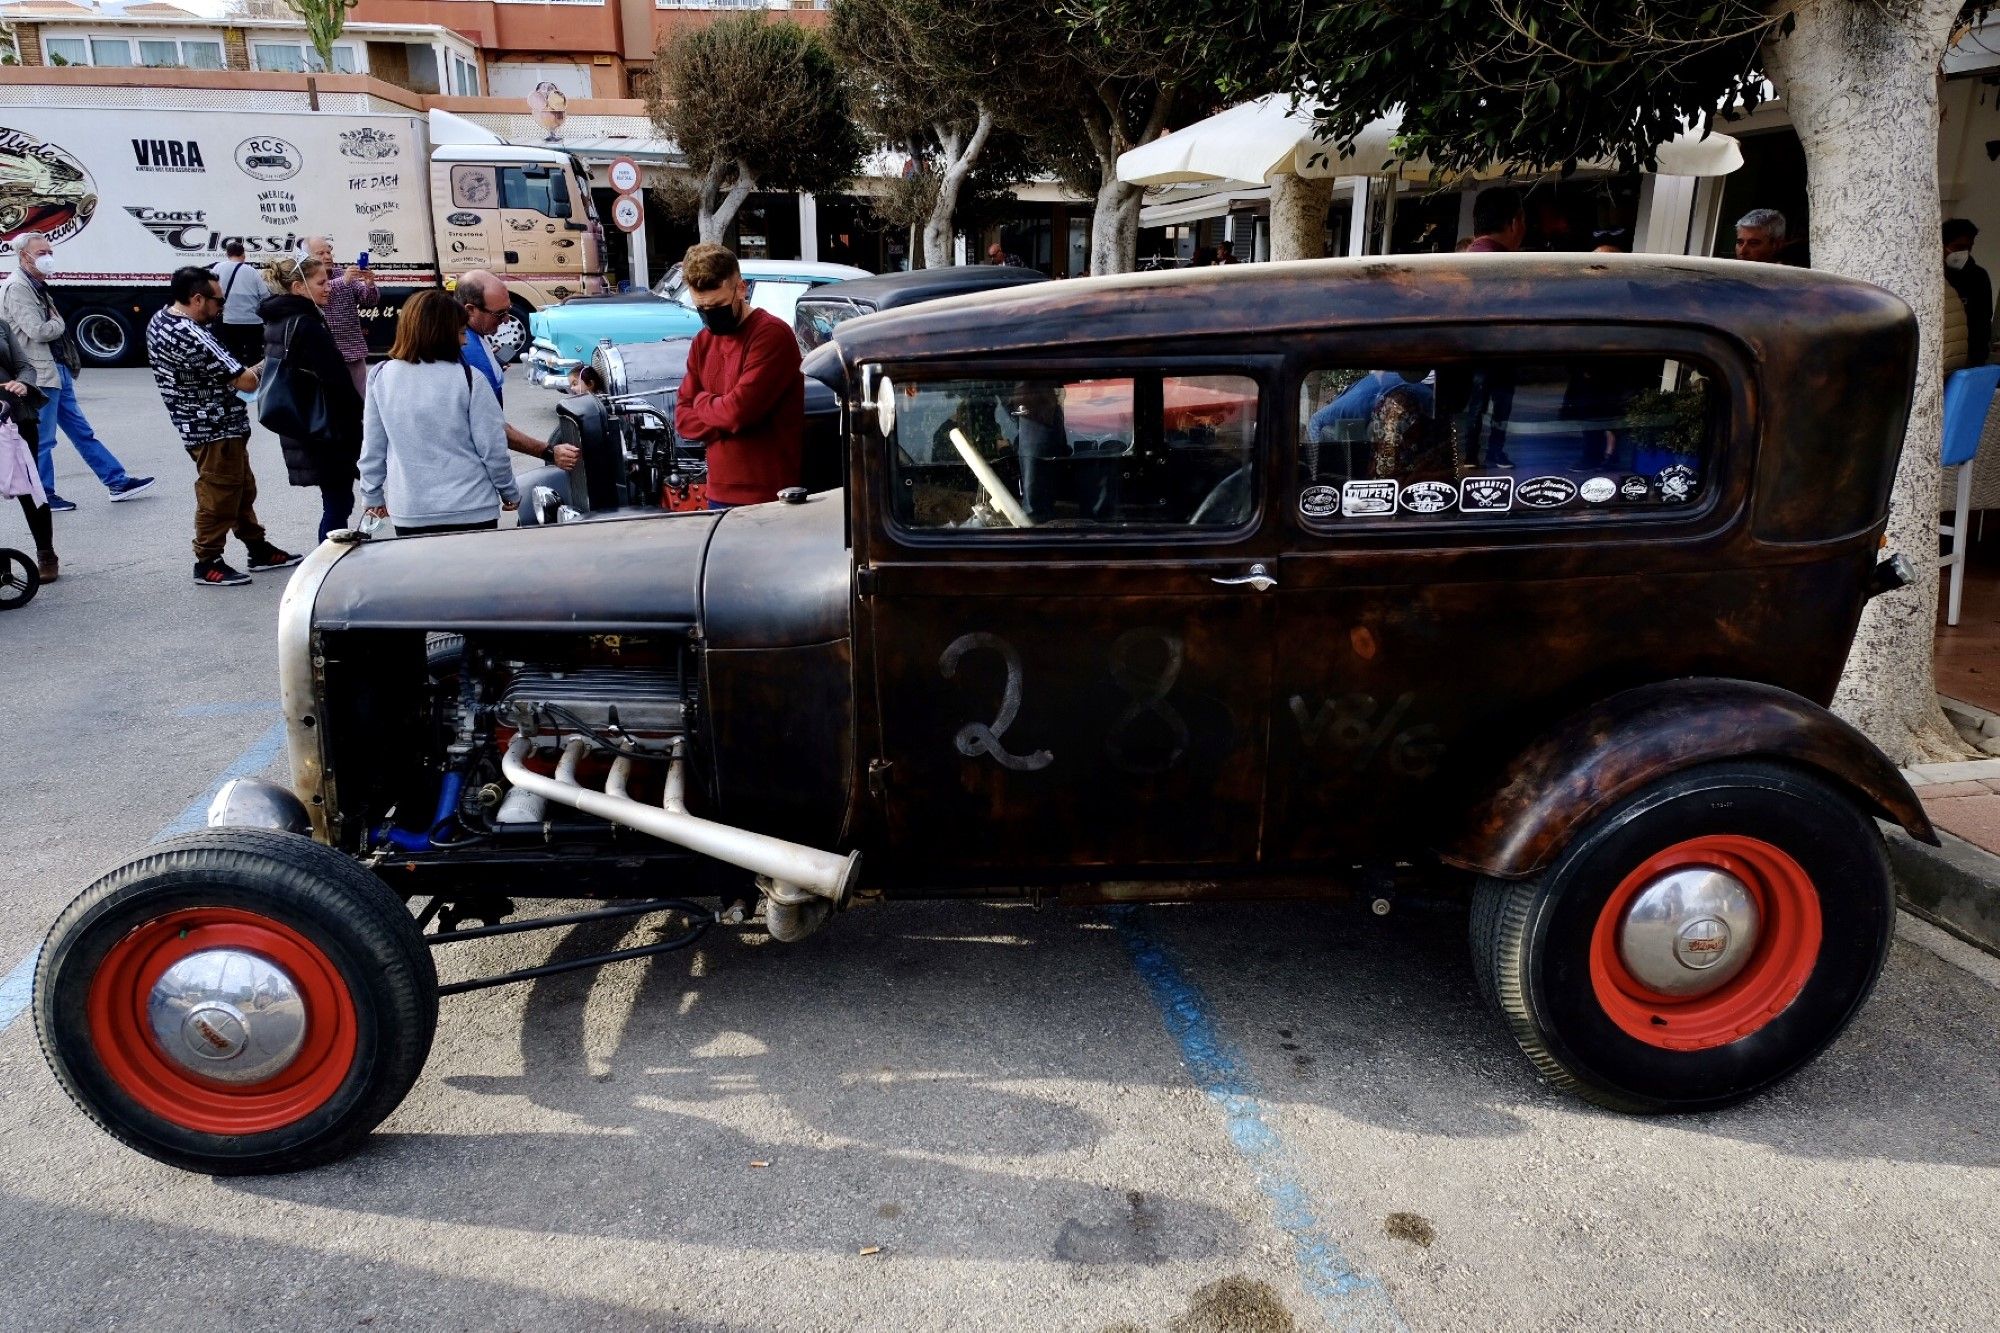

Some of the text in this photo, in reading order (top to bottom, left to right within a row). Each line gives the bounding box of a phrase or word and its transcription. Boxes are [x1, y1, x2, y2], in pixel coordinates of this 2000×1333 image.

[131, 139, 204, 167] VHRA
[250, 140, 284, 154] RCS
[349, 179, 366, 190] THE
[371, 173, 398, 188] DASH
[257, 190, 295, 201] AMERICAN
[135, 207, 206, 221] Coast
[260, 203, 297, 212] HOT ROD
[261, 214, 298, 225] FOUNDATION
[357, 304, 380, 321] eep
[1466, 480, 1509, 491] DIAMANTES
